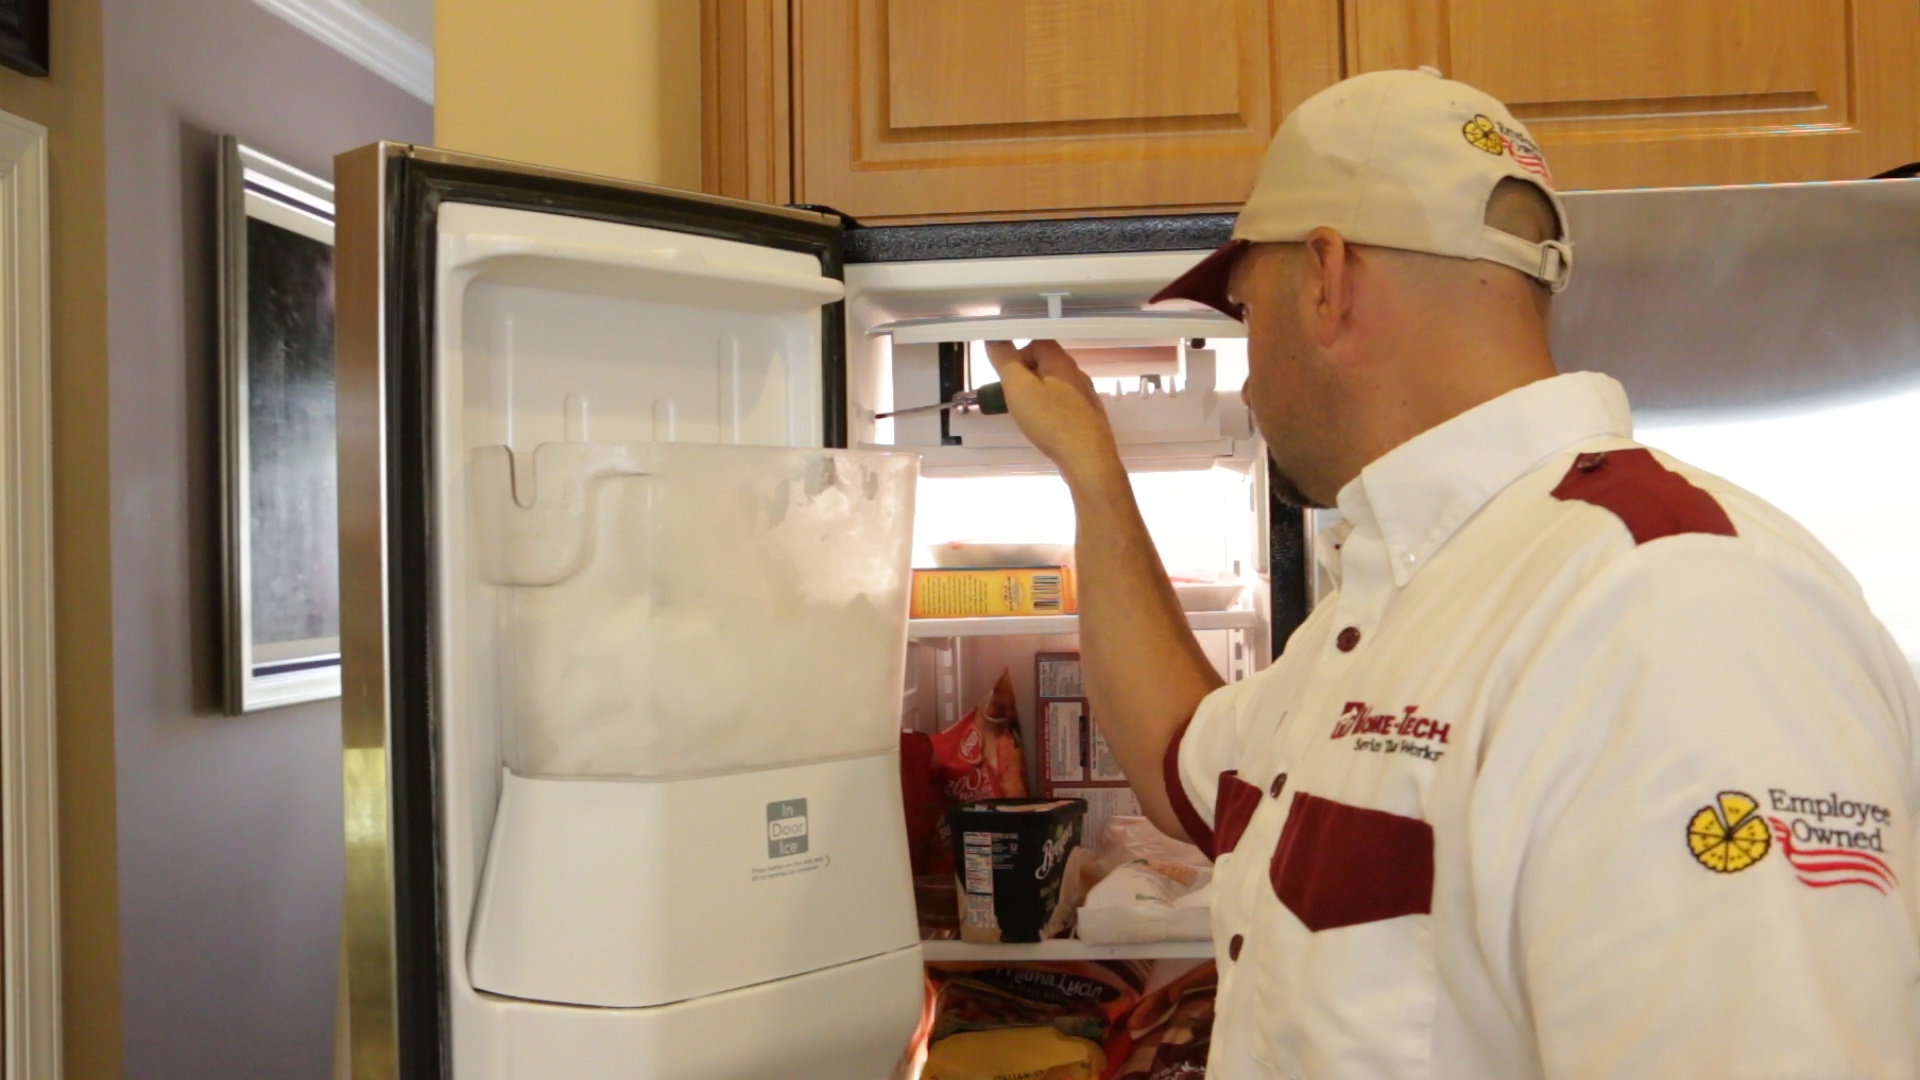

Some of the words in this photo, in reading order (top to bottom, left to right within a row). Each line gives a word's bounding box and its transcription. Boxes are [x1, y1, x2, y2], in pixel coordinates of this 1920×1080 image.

[782, 804, 795, 817] In
[1768, 788, 1891, 827] Employee
[772, 822, 804, 837] Door
[1791, 818, 1886, 853] Owned
[779, 840, 798, 854] Ice
